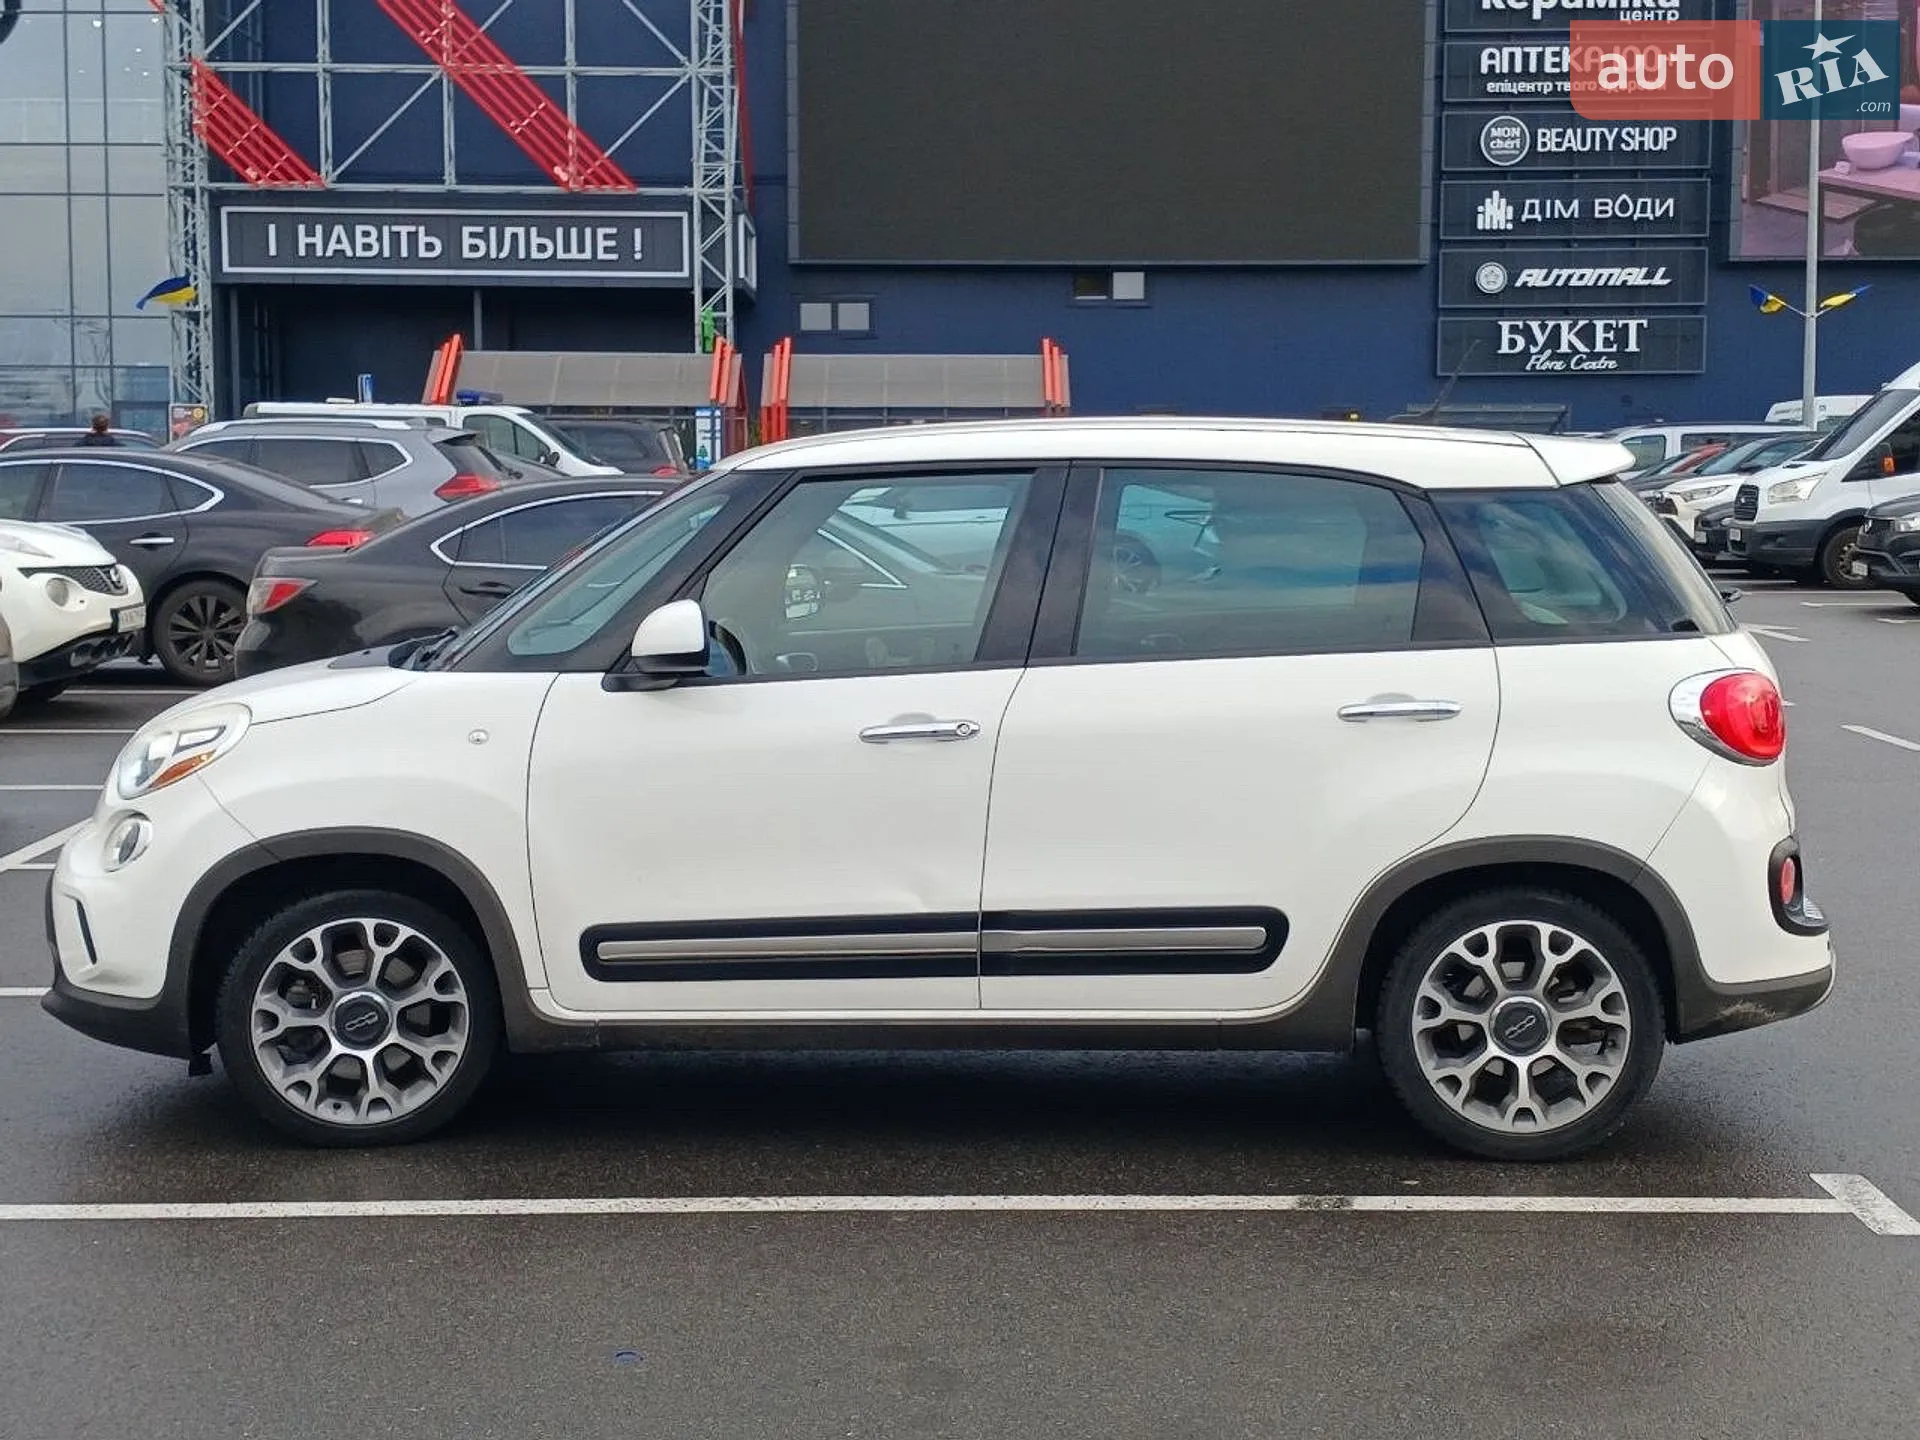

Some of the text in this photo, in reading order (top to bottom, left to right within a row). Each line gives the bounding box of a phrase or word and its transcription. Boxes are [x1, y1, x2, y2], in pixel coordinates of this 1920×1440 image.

[1619, 9, 1679, 24] центр
[1536, 127, 1677, 153] BEAUTY SHOP
[1521, 193, 1675, 222] ДІМ ВОДИ
[268, 223, 277, 257] І
[297, 223, 443, 259] НАВІТЬ
[461, 226, 619, 261] БІЛЬШЕ
[1514, 266, 1672, 288] AUTOMALL
[1496, 318, 1649, 354] БУКЕТ
